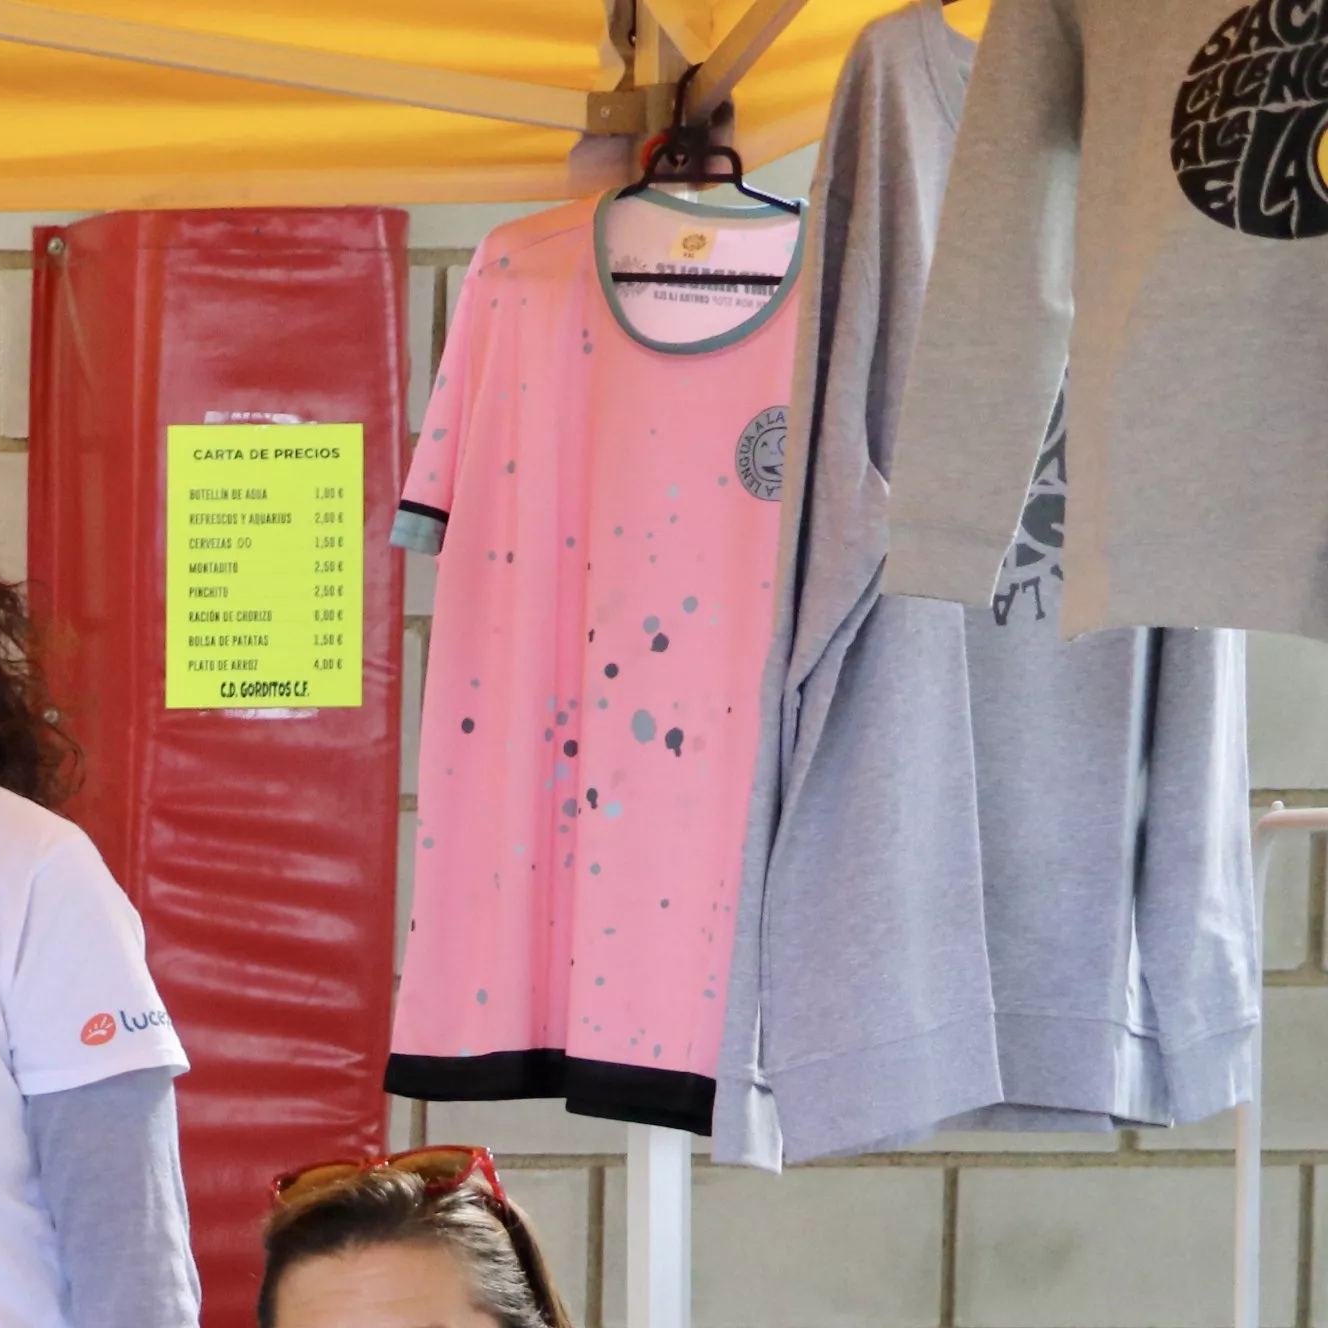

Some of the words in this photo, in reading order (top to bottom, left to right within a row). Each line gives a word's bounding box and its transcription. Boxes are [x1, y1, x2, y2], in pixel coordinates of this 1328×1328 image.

[1187, 0, 1328, 76] SAC
[766, 411, 785, 425] LA
[193, 449, 244, 460] CARTA
[249, 448, 269, 459] DE
[274, 448, 341, 459] PRECIOS
[232, 488, 242, 500] DE
[245, 488, 268, 500] AGUA
[189, 513, 237, 525] REFRESCOS
[241, 513, 246, 525] Y
[249, 513, 292, 525] AQUARIUS
[189, 538, 232, 549] CERVEZAS
[189, 562, 238, 574] MONTADITO
[314, 561, 335, 573] 2,50
[189, 586, 229, 598] PINCHITO
[314, 585, 335, 597] 2,50
[223, 610, 233, 622] DE
[236, 610, 272, 622] CHORIZO
[189, 635, 216, 647] BOLSA
[219, 635, 230, 647] DE
[232, 635, 269, 647] PATATAS
[188, 660, 215, 671] PLATO
[218, 660, 229, 671] DE
[231, 660, 258, 671] ARROZ
[240, 682, 292, 698] GORDITOS
